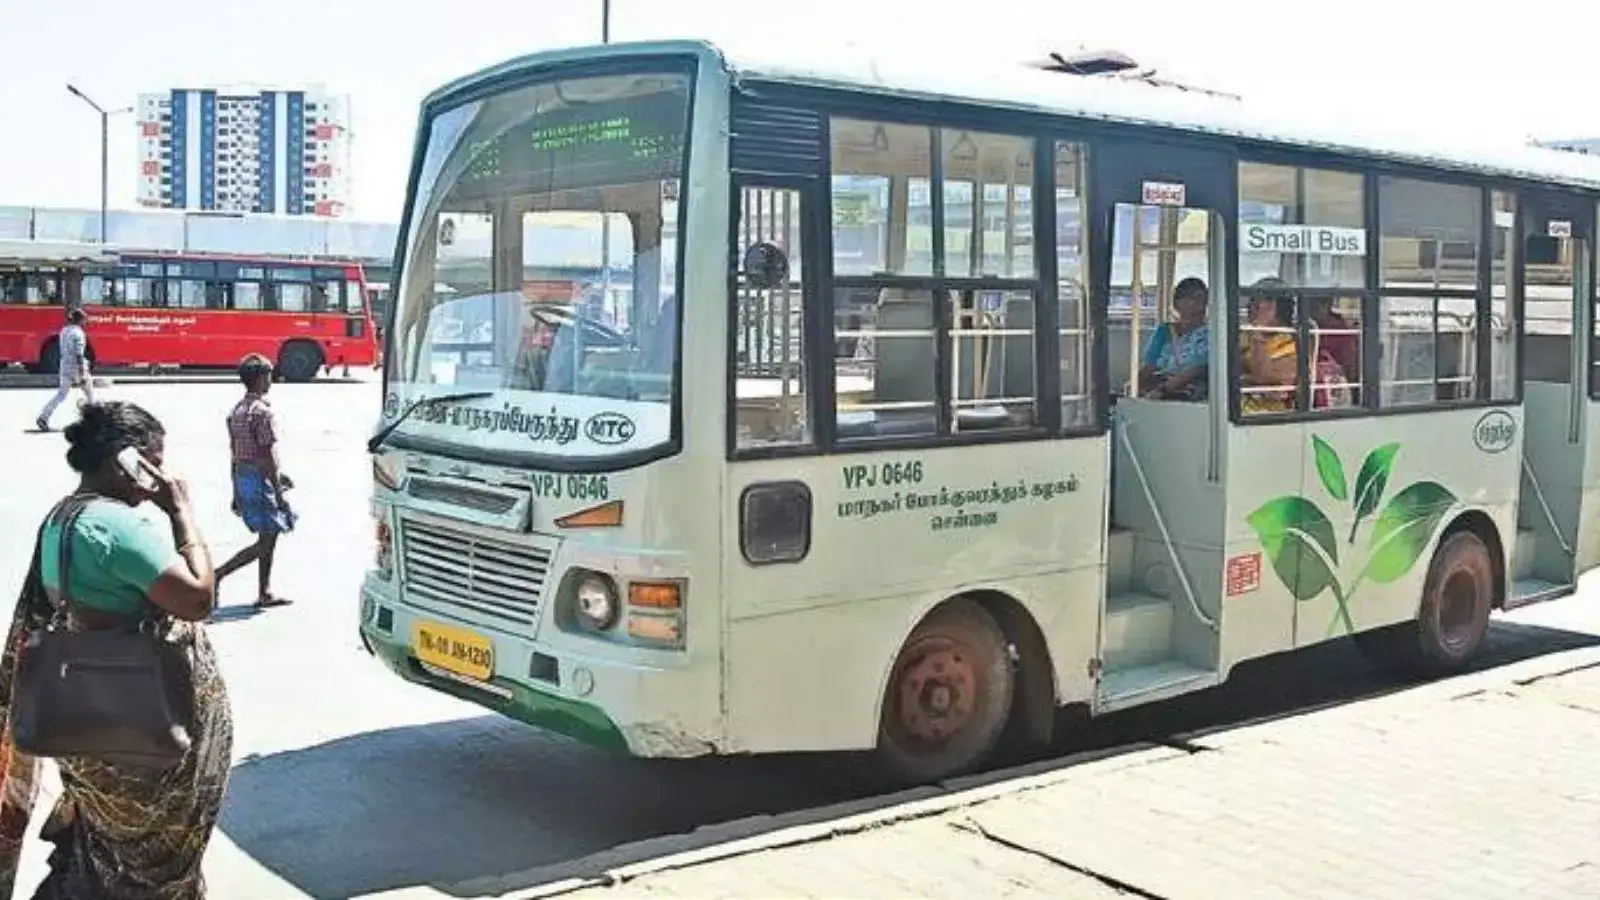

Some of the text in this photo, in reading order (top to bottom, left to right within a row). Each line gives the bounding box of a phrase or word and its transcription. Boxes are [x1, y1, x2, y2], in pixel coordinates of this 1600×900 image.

[1249, 226, 1360, 252] Small Bus
[590, 418, 631, 439] MTC
[532, 472, 609, 500] VPJ 0646
[842, 460, 923, 489] VPJ 0646
